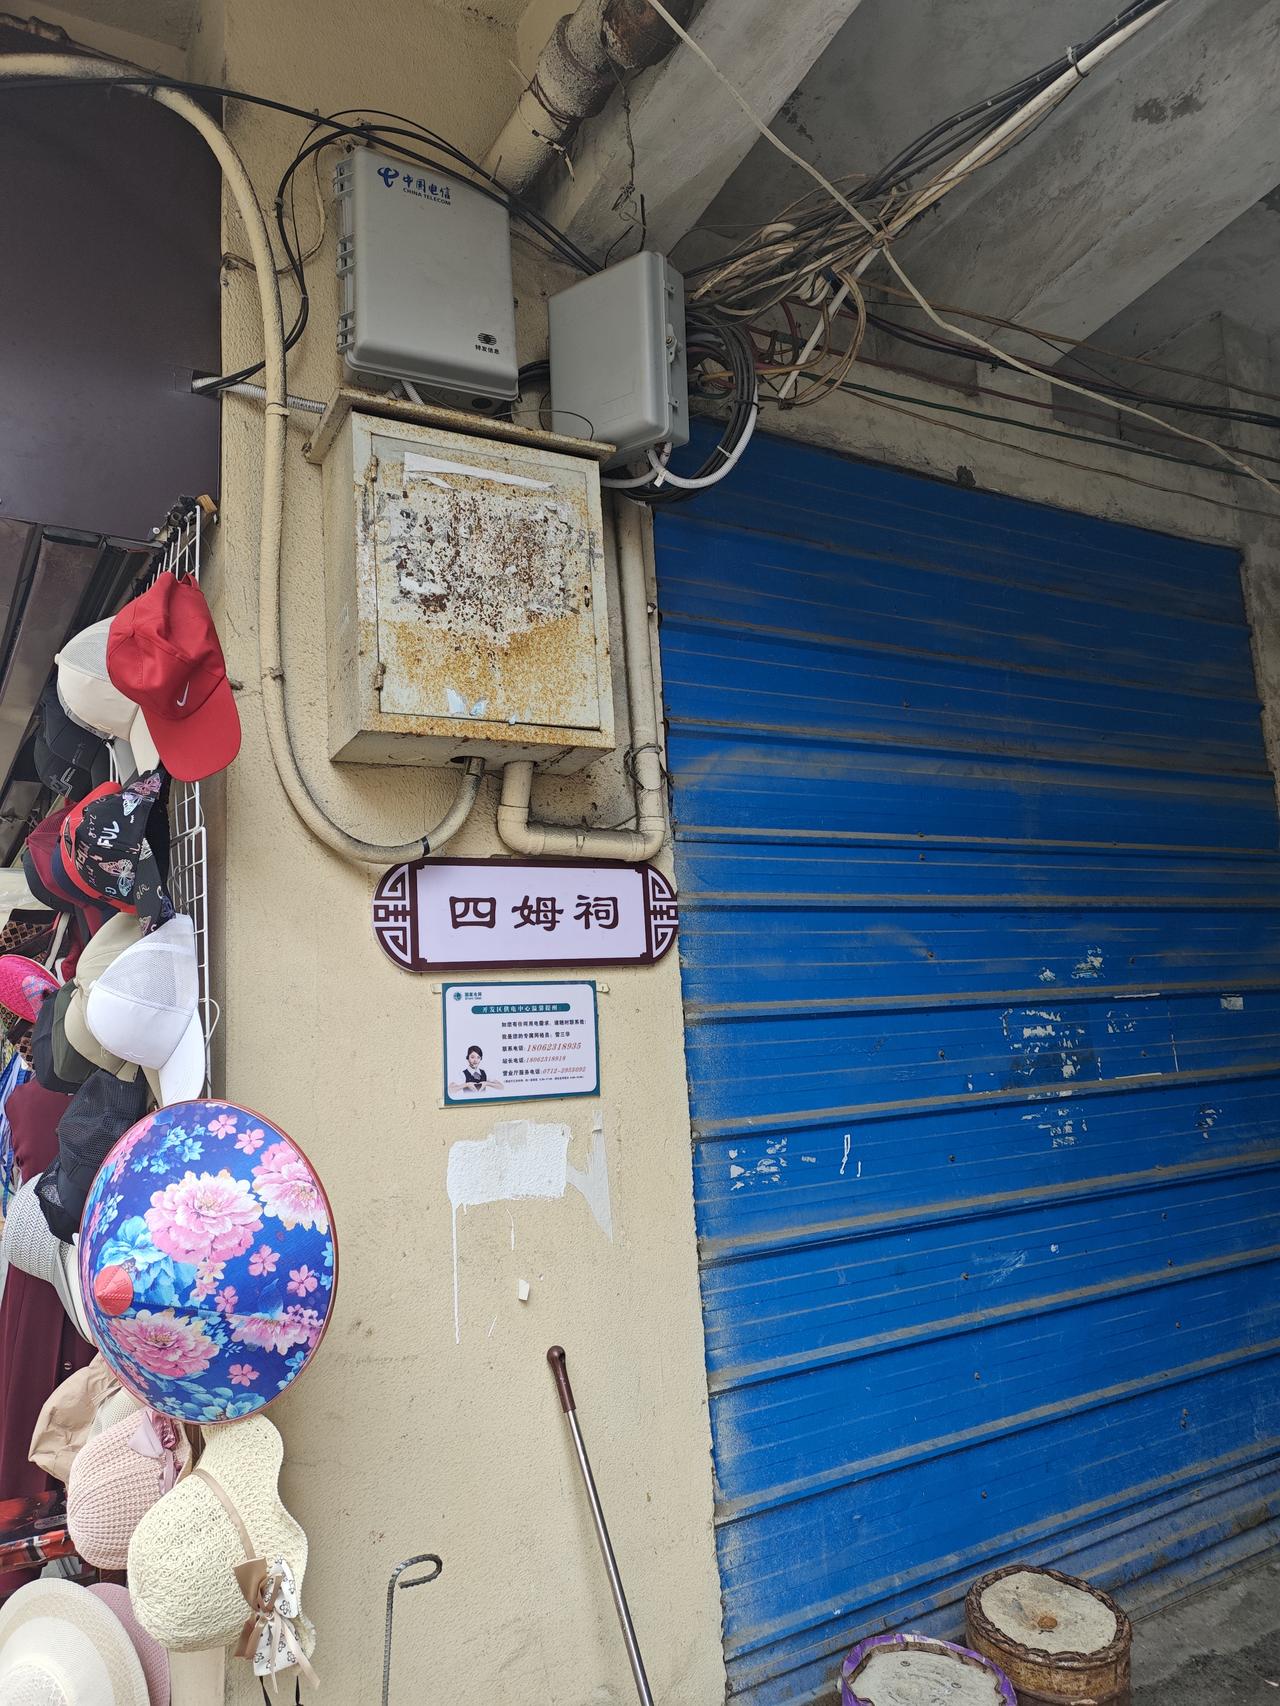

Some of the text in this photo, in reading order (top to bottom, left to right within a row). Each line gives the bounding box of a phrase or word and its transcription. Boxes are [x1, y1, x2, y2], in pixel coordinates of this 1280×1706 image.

[402, 174, 451, 200] 中国电信
[402, 187, 451, 206] CHINA TELECOM
[449, 895, 619, 932] 四姆祠
